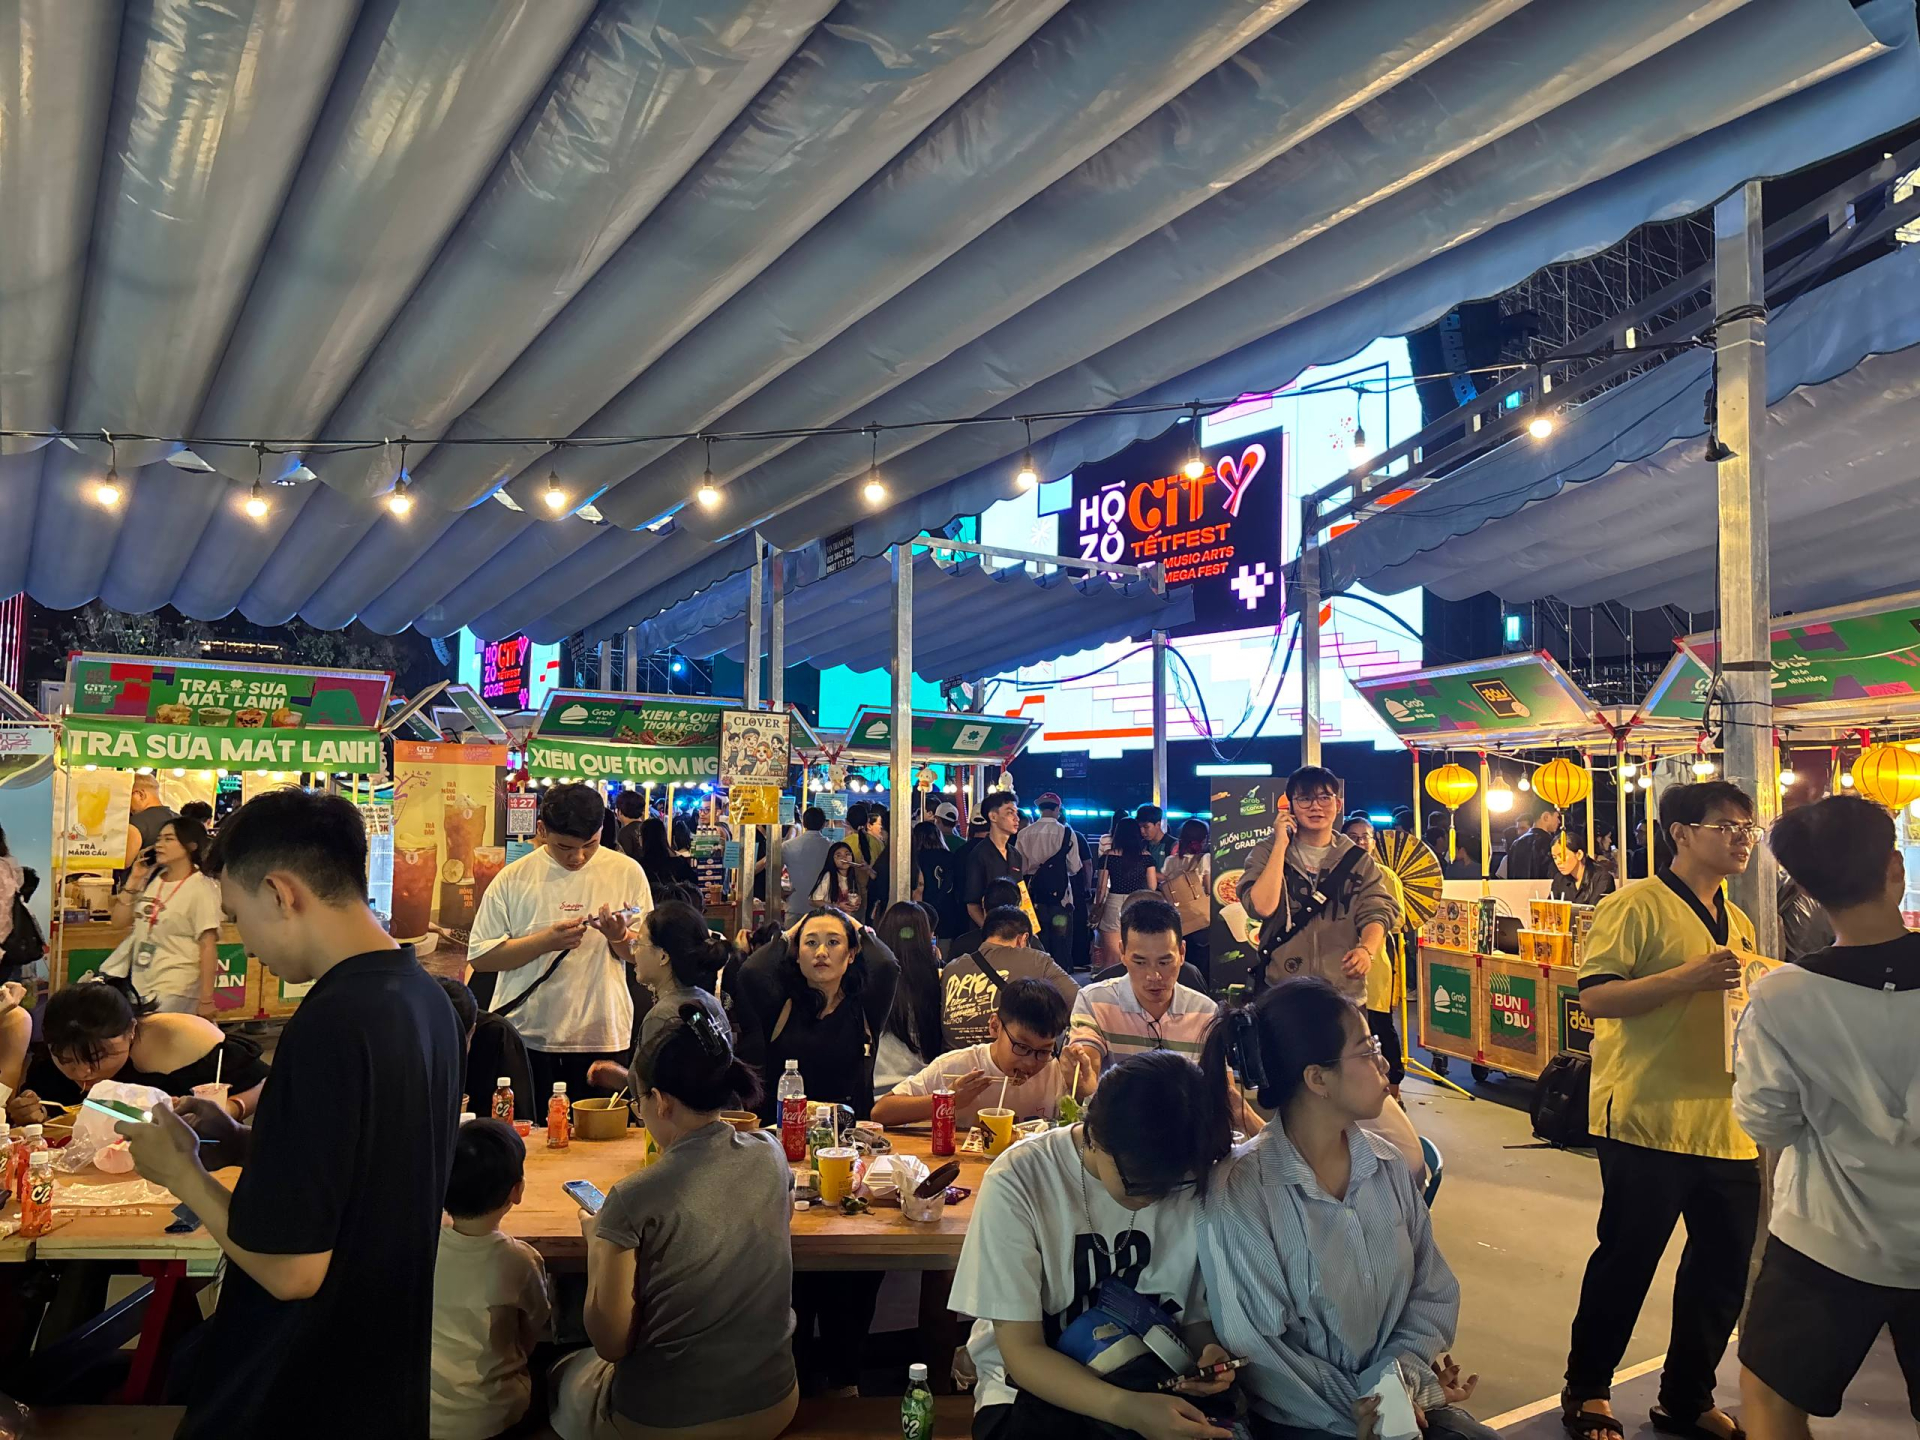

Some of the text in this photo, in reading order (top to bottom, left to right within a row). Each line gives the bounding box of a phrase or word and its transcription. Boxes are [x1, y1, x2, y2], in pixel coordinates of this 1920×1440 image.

[1163, 546, 1234, 568] MUSIC ARTS
[1164, 567, 1197, 583] MEGA
[1198, 562, 1229, 577] FEST
[484, 682, 503, 698] 2025
[592, 708, 616, 717] Grab
[690, 712, 720, 724] QUE
[734, 717, 780, 728] CLOVER
[147, 732, 213, 761] SỮA
[220, 733, 295, 762] MÁT
[303, 740, 376, 766] LẠNH
[579, 754, 624, 776] QUE
[519, 799, 535, 808] 27
[1235, 839, 1256, 850] GRAB
[1451, 991, 1467, 1003] Grab
[495, 1102, 510, 1117] C2
[31, 1185, 51, 1204] C2
[902, 1414, 920, 1439] C2
